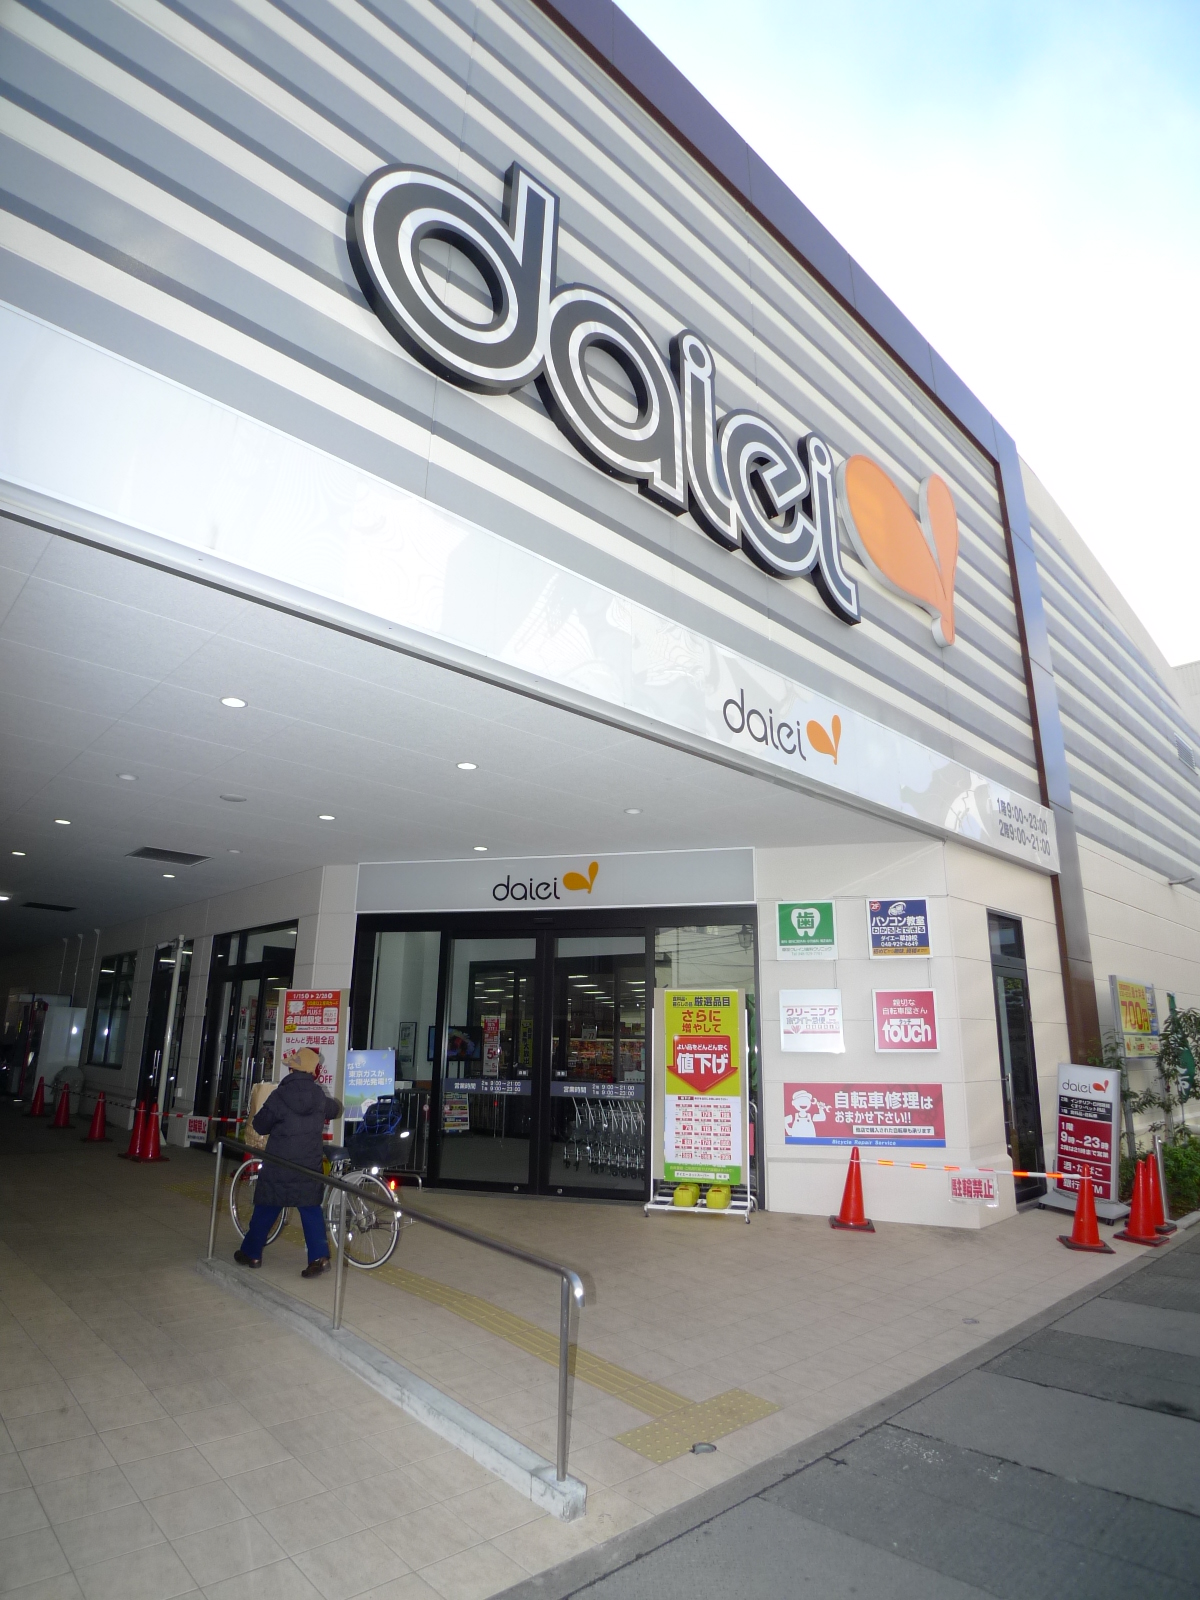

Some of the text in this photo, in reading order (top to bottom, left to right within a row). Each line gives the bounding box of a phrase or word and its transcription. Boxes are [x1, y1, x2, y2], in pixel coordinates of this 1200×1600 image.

[346, 162, 861, 625] daiei
[723, 688, 807, 761] daiei
[492, 874, 560, 901] daiei
[796, 911, 815, 930] 歯
[872, 915, 926, 927] パソコン教室
[872, 926, 926, 935] わかるとできる
[694, 996, 730, 1007] 厳選品目
[892, 998, 916, 1006] 親切な
[681, 1009, 722, 1023] さらに
[786, 1007, 838, 1016] クリーニング
[882, 1007, 928, 1015] 自転車屋さん
[1120, 1000, 1150, 1031] 700円
[786, 1016, 826, 1025] ホワイト急便
[681, 1023, 722, 1033] 増やして
[882, 1018, 932, 1043] touch
[285, 1035, 335, 1045] ほとんど売場全品
[676, 1043, 728, 1051] よい品をどんどん安く
[676, 1052, 729, 1075] 値下げ
[318, 1075, 333, 1084] OFF
[348, 1070, 385, 1078] 東京ガスが
[1062, 1079, 1092, 1094] daiei
[834, 1090, 934, 1110] 自転車修理は
[834, 1111, 912, 1124] おまかせ下さい!!
[1061, 1121, 1074, 1132] 1階
[951, 1178, 995, 1199] 駐輪禁止
